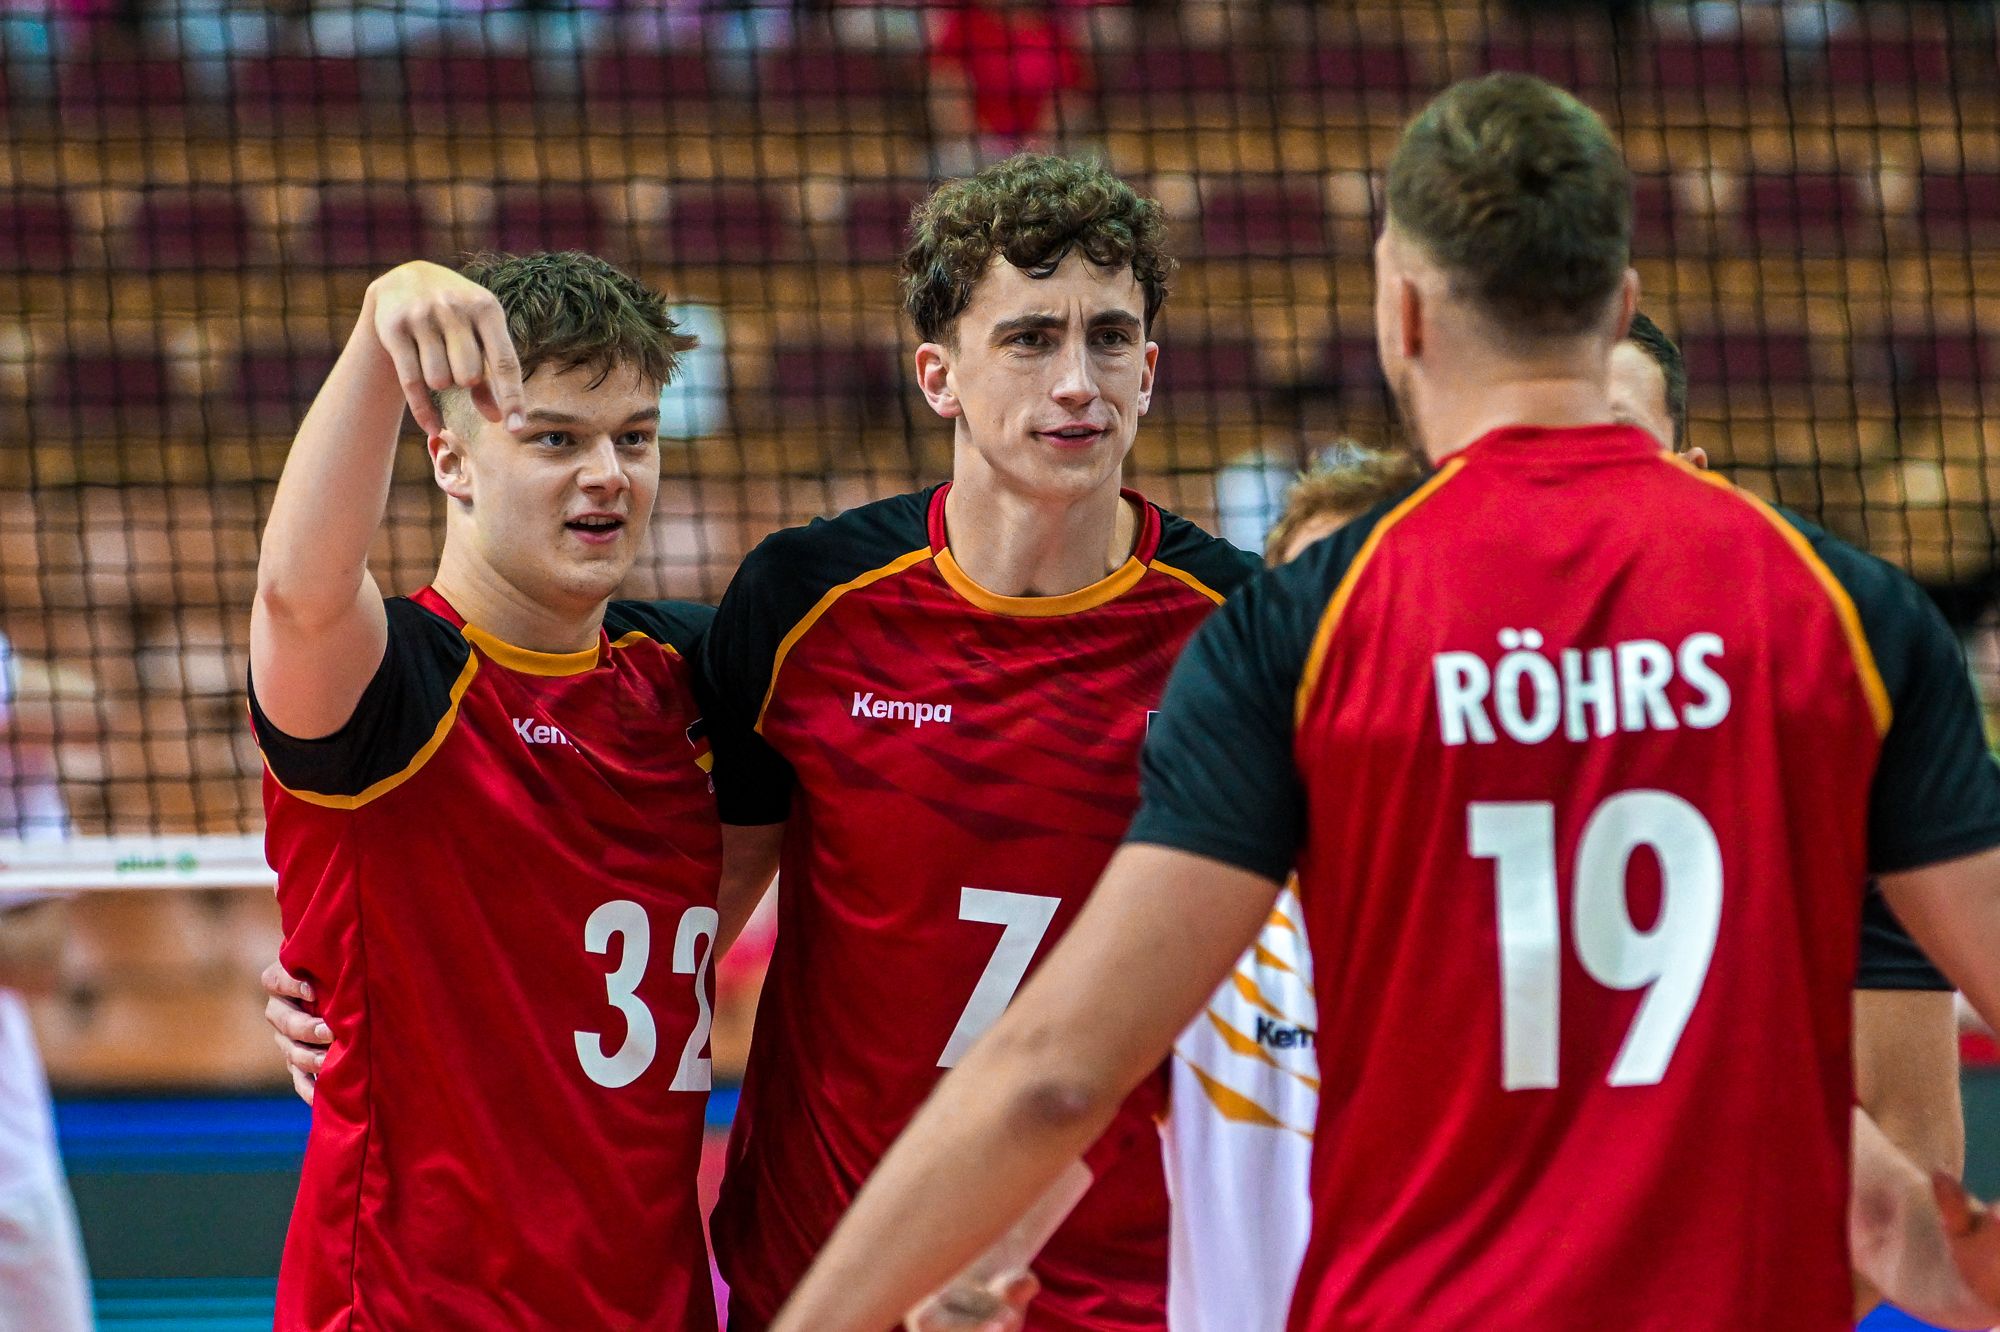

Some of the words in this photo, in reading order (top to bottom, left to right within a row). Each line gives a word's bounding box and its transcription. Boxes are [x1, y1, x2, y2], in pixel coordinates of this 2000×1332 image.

[851, 691, 952, 728] Kempa
[1433, 627, 1731, 746] RÖHRS
[574, 899, 719, 1092] 32
[936, 886, 1062, 1069] 7
[1467, 788, 1725, 1092] 19
[1256, 1015, 1315, 1049] Kem
